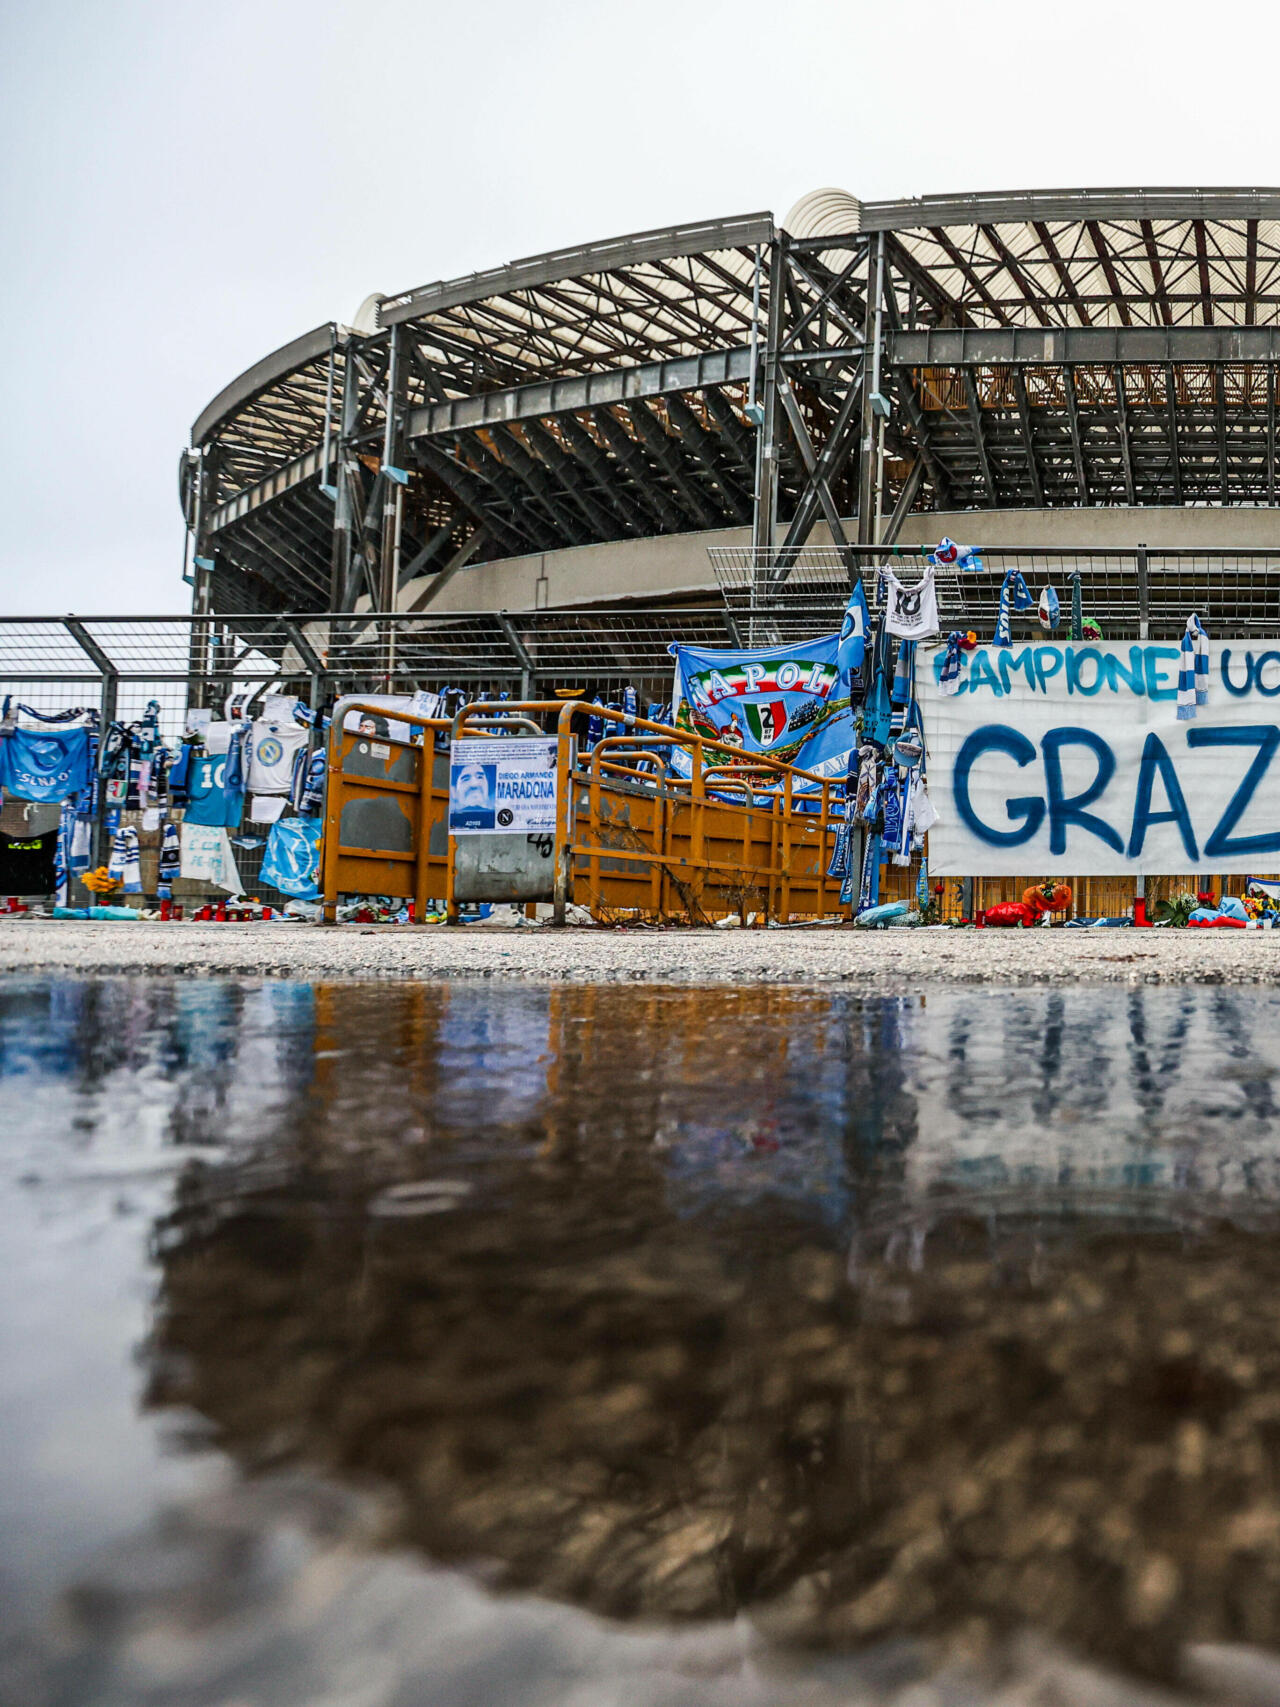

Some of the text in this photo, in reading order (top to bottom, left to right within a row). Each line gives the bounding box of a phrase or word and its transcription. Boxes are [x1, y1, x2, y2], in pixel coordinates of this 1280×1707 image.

[933, 646, 1180, 701] CAMPIONE
[760, 707, 775, 728] 2
[498, 771, 554, 780] DIEGO ARMANDO
[497, 781, 555, 799] MARADONA
